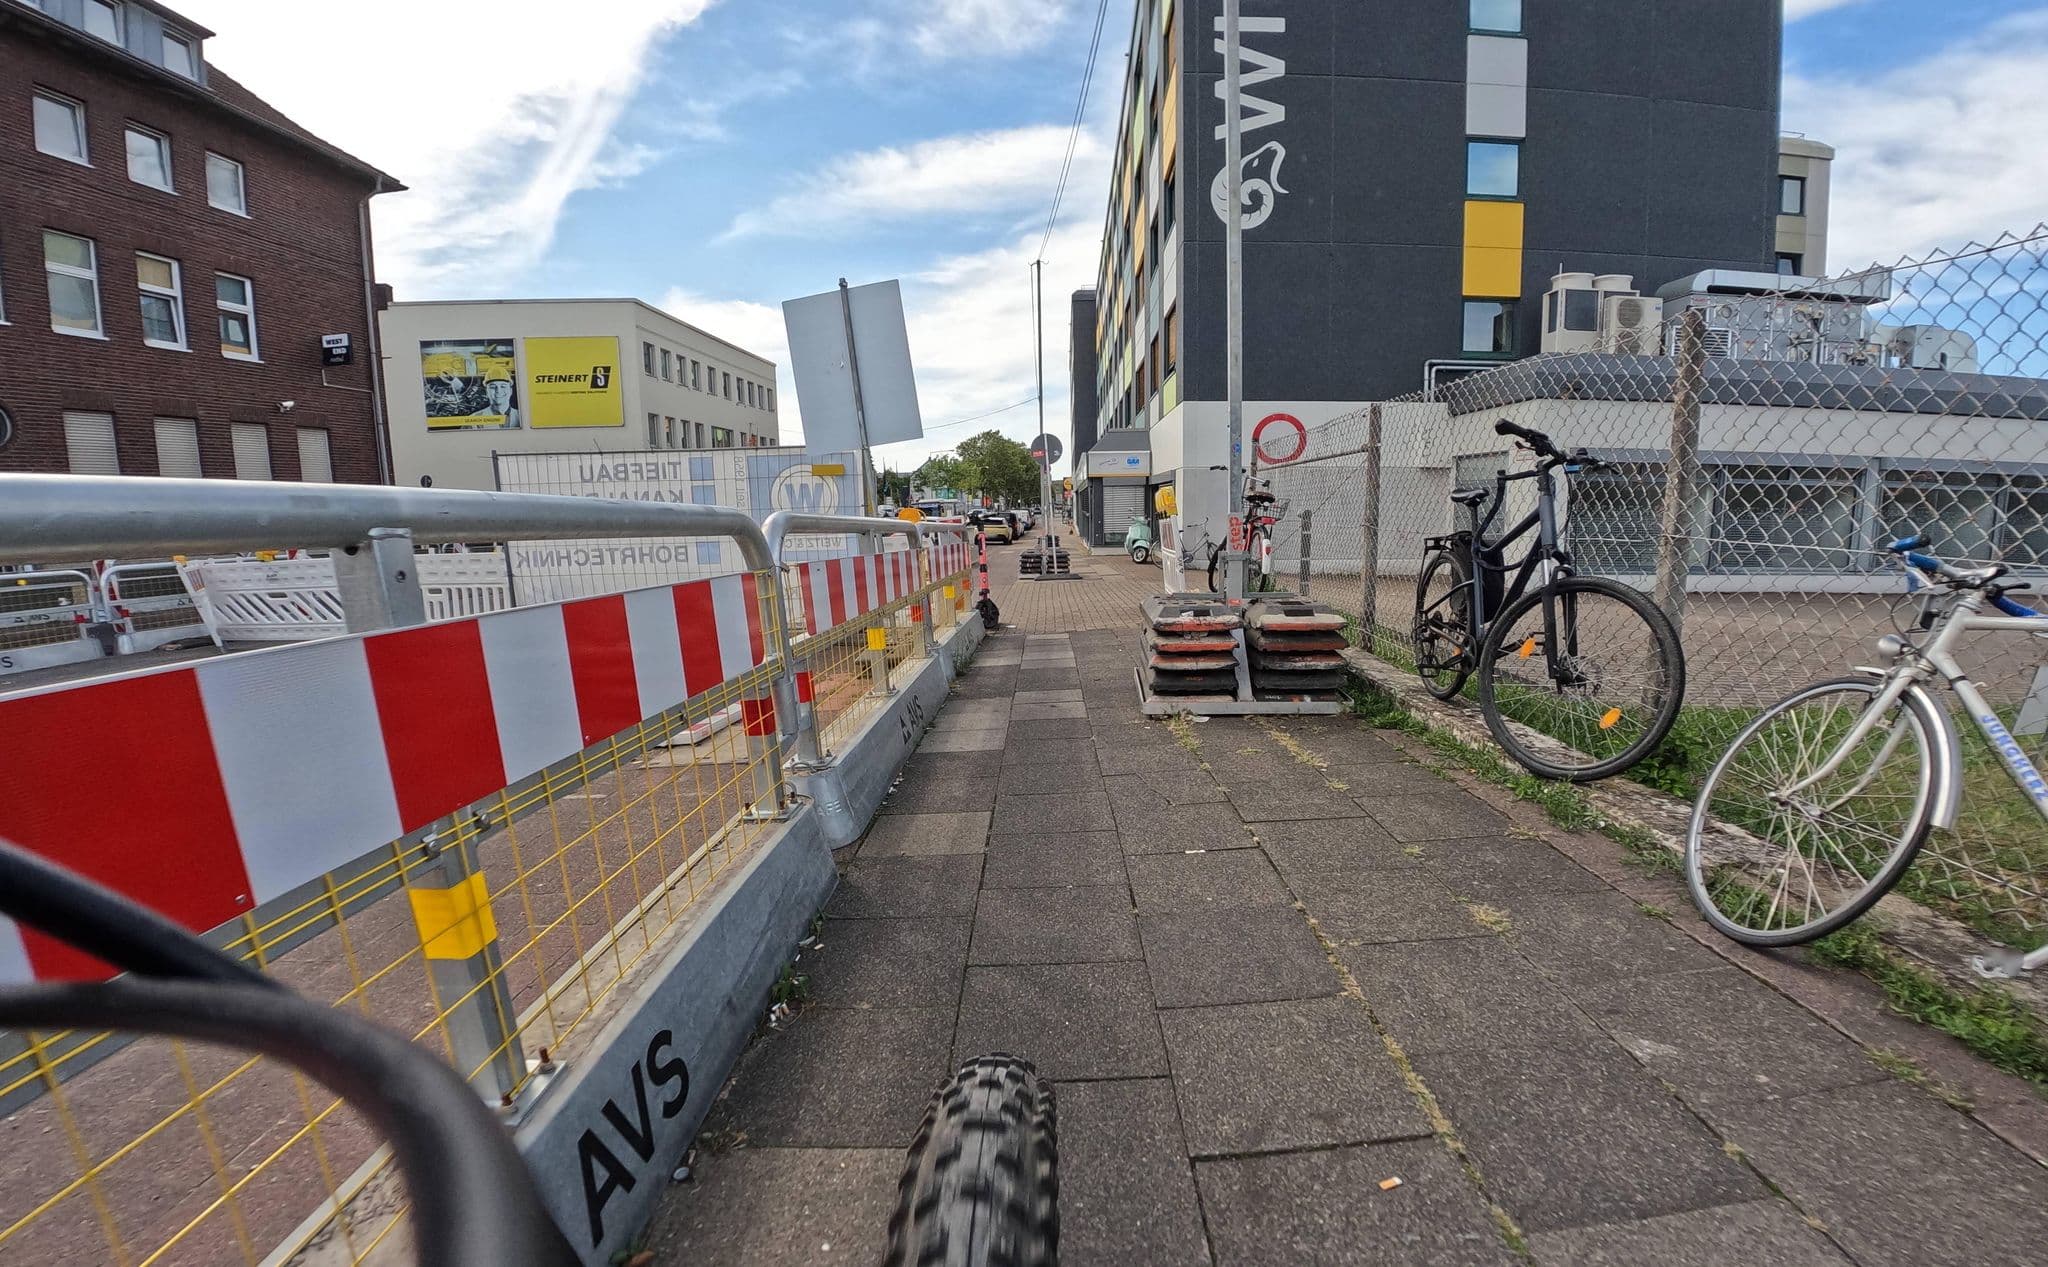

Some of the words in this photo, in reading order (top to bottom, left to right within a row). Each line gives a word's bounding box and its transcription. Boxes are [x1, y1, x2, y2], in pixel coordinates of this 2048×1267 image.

[535, 374, 589, 384] STEINERT
[906, 695, 924, 729] AVS
[578, 1029, 690, 1249] AVS
